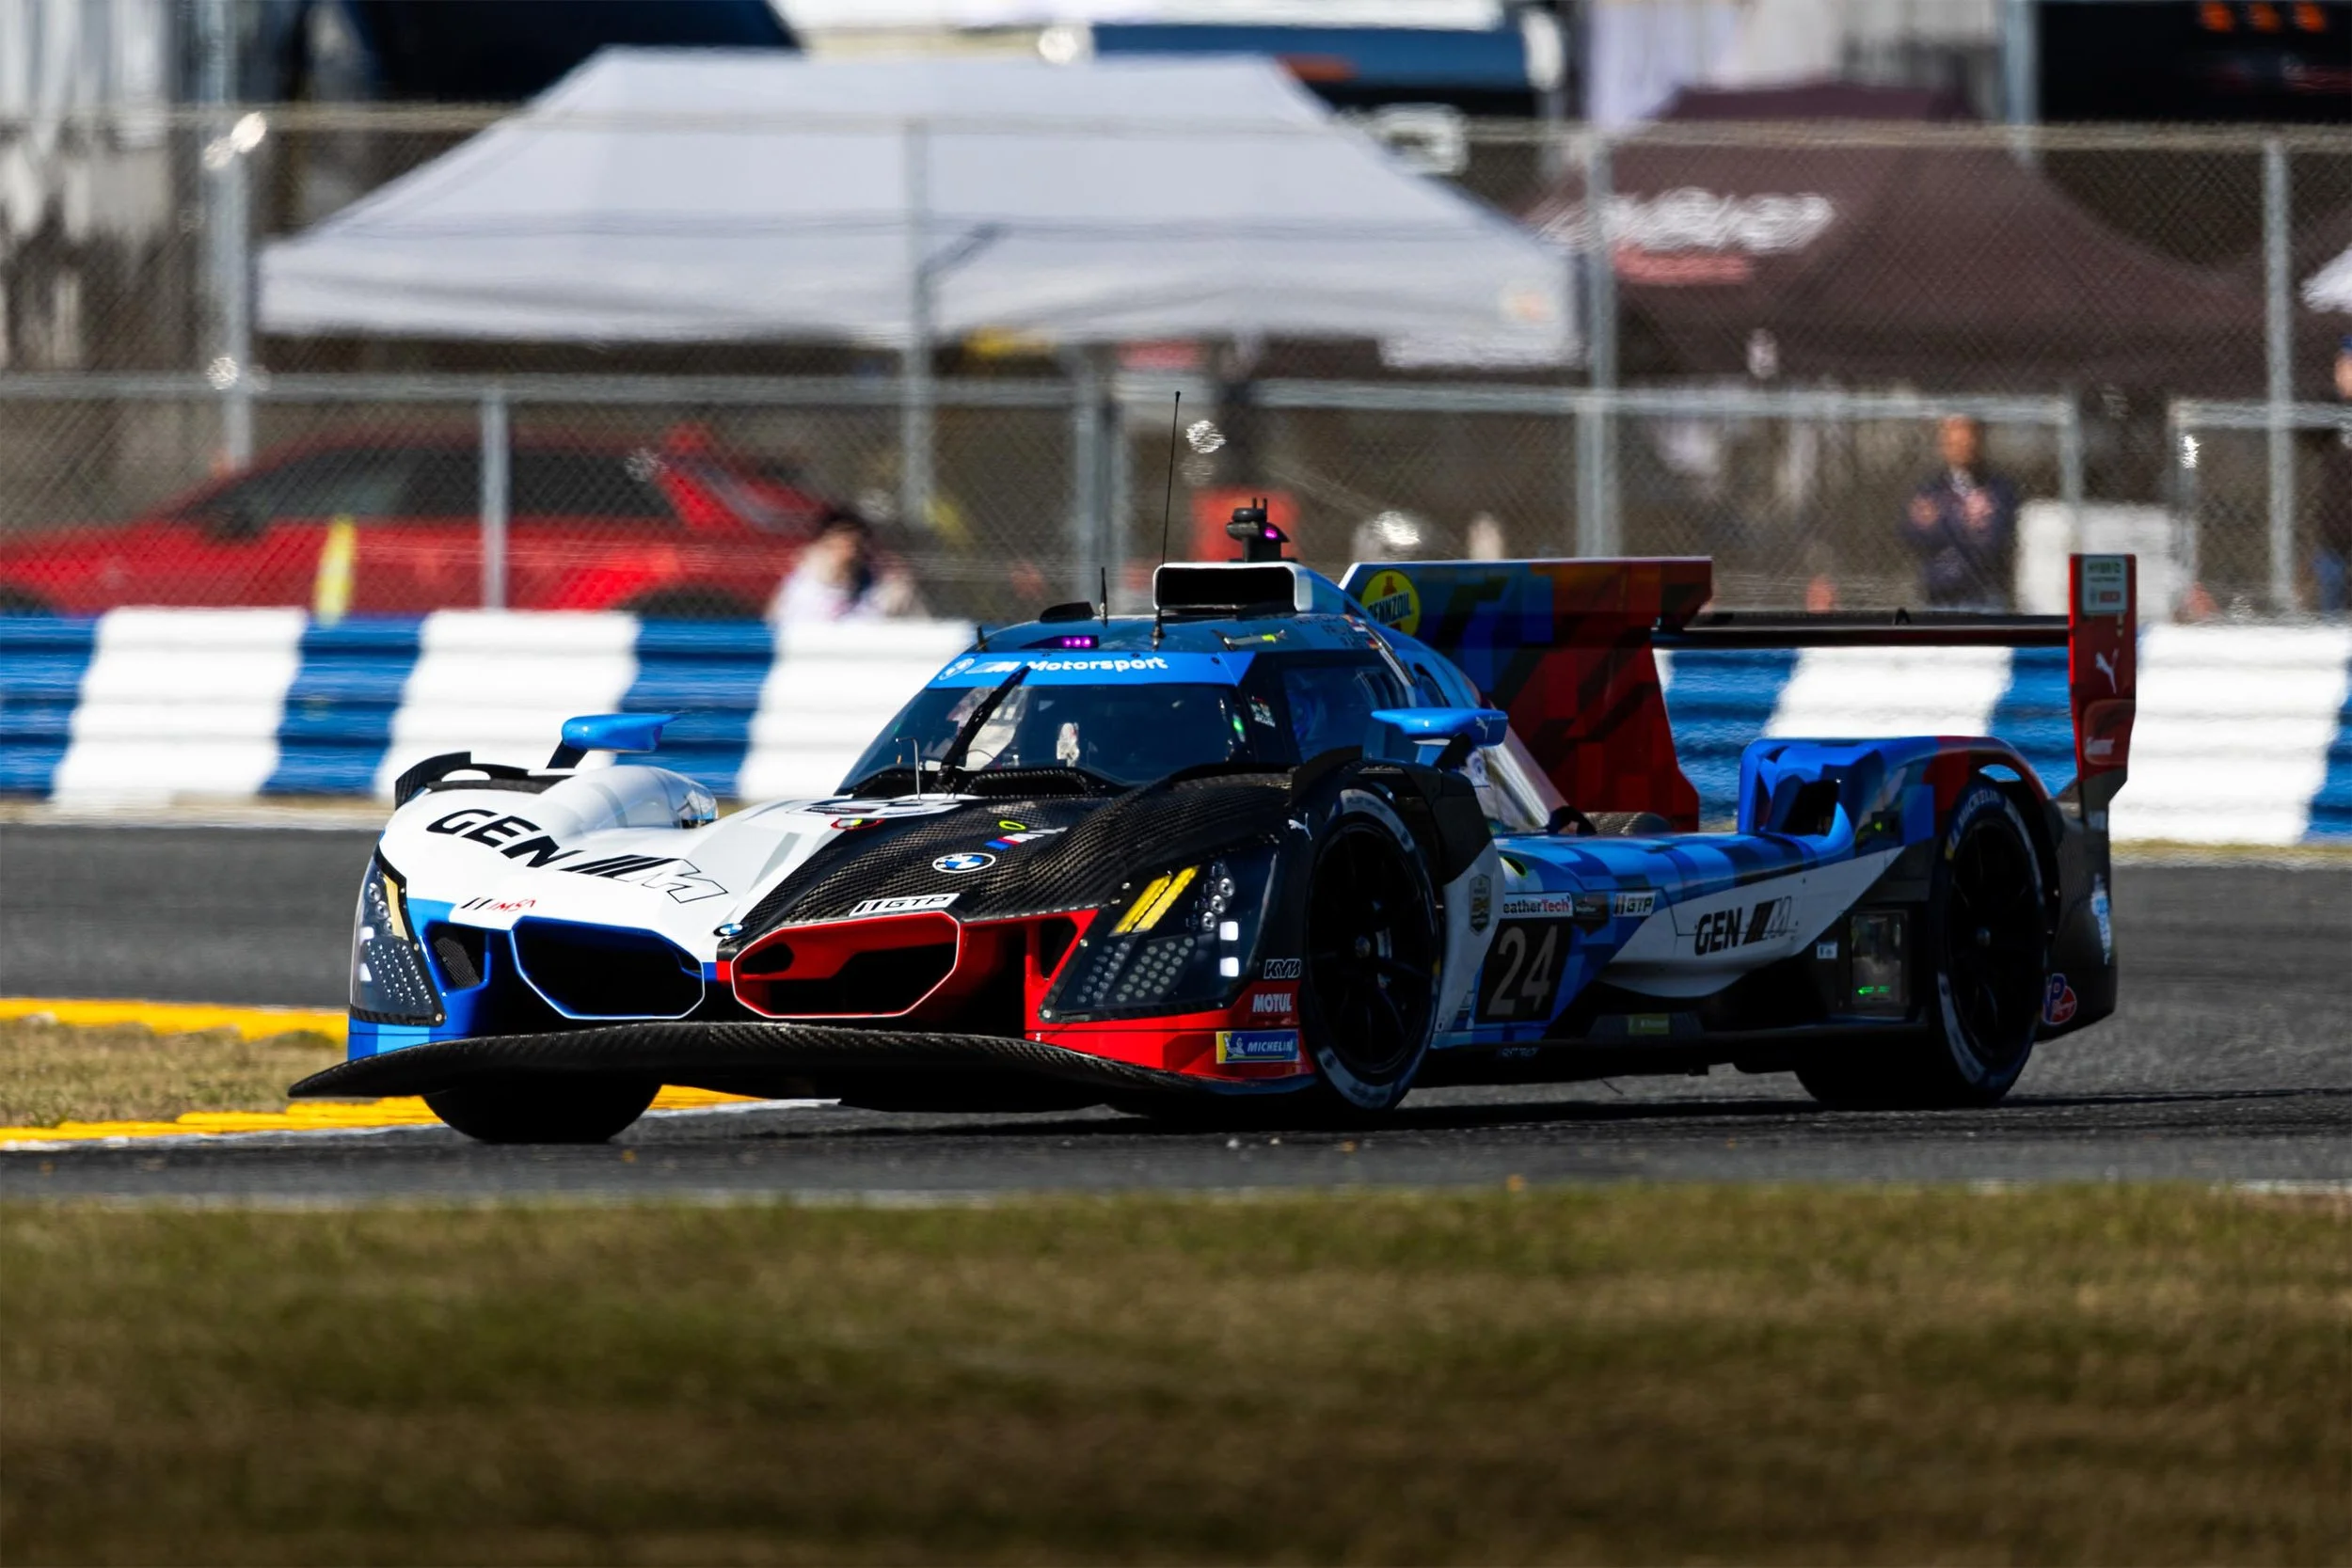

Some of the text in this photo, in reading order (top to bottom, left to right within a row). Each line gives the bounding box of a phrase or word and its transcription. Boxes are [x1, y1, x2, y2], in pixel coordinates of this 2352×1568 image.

[1027, 657, 1168, 673] Motorsport
[426, 809, 585, 868] GEN
[884, 895, 947, 909] GTP
[1503, 895, 1570, 913] eatherTech
[1627, 899, 1652, 913] GTP
[1694, 908, 1742, 956] GEN
[1263, 958, 1302, 979] KYB
[1486, 925, 1559, 1016] 24
[1252, 993, 1292, 1013] MOTUL
[1248, 1040, 1294, 1053] MICHELIN
